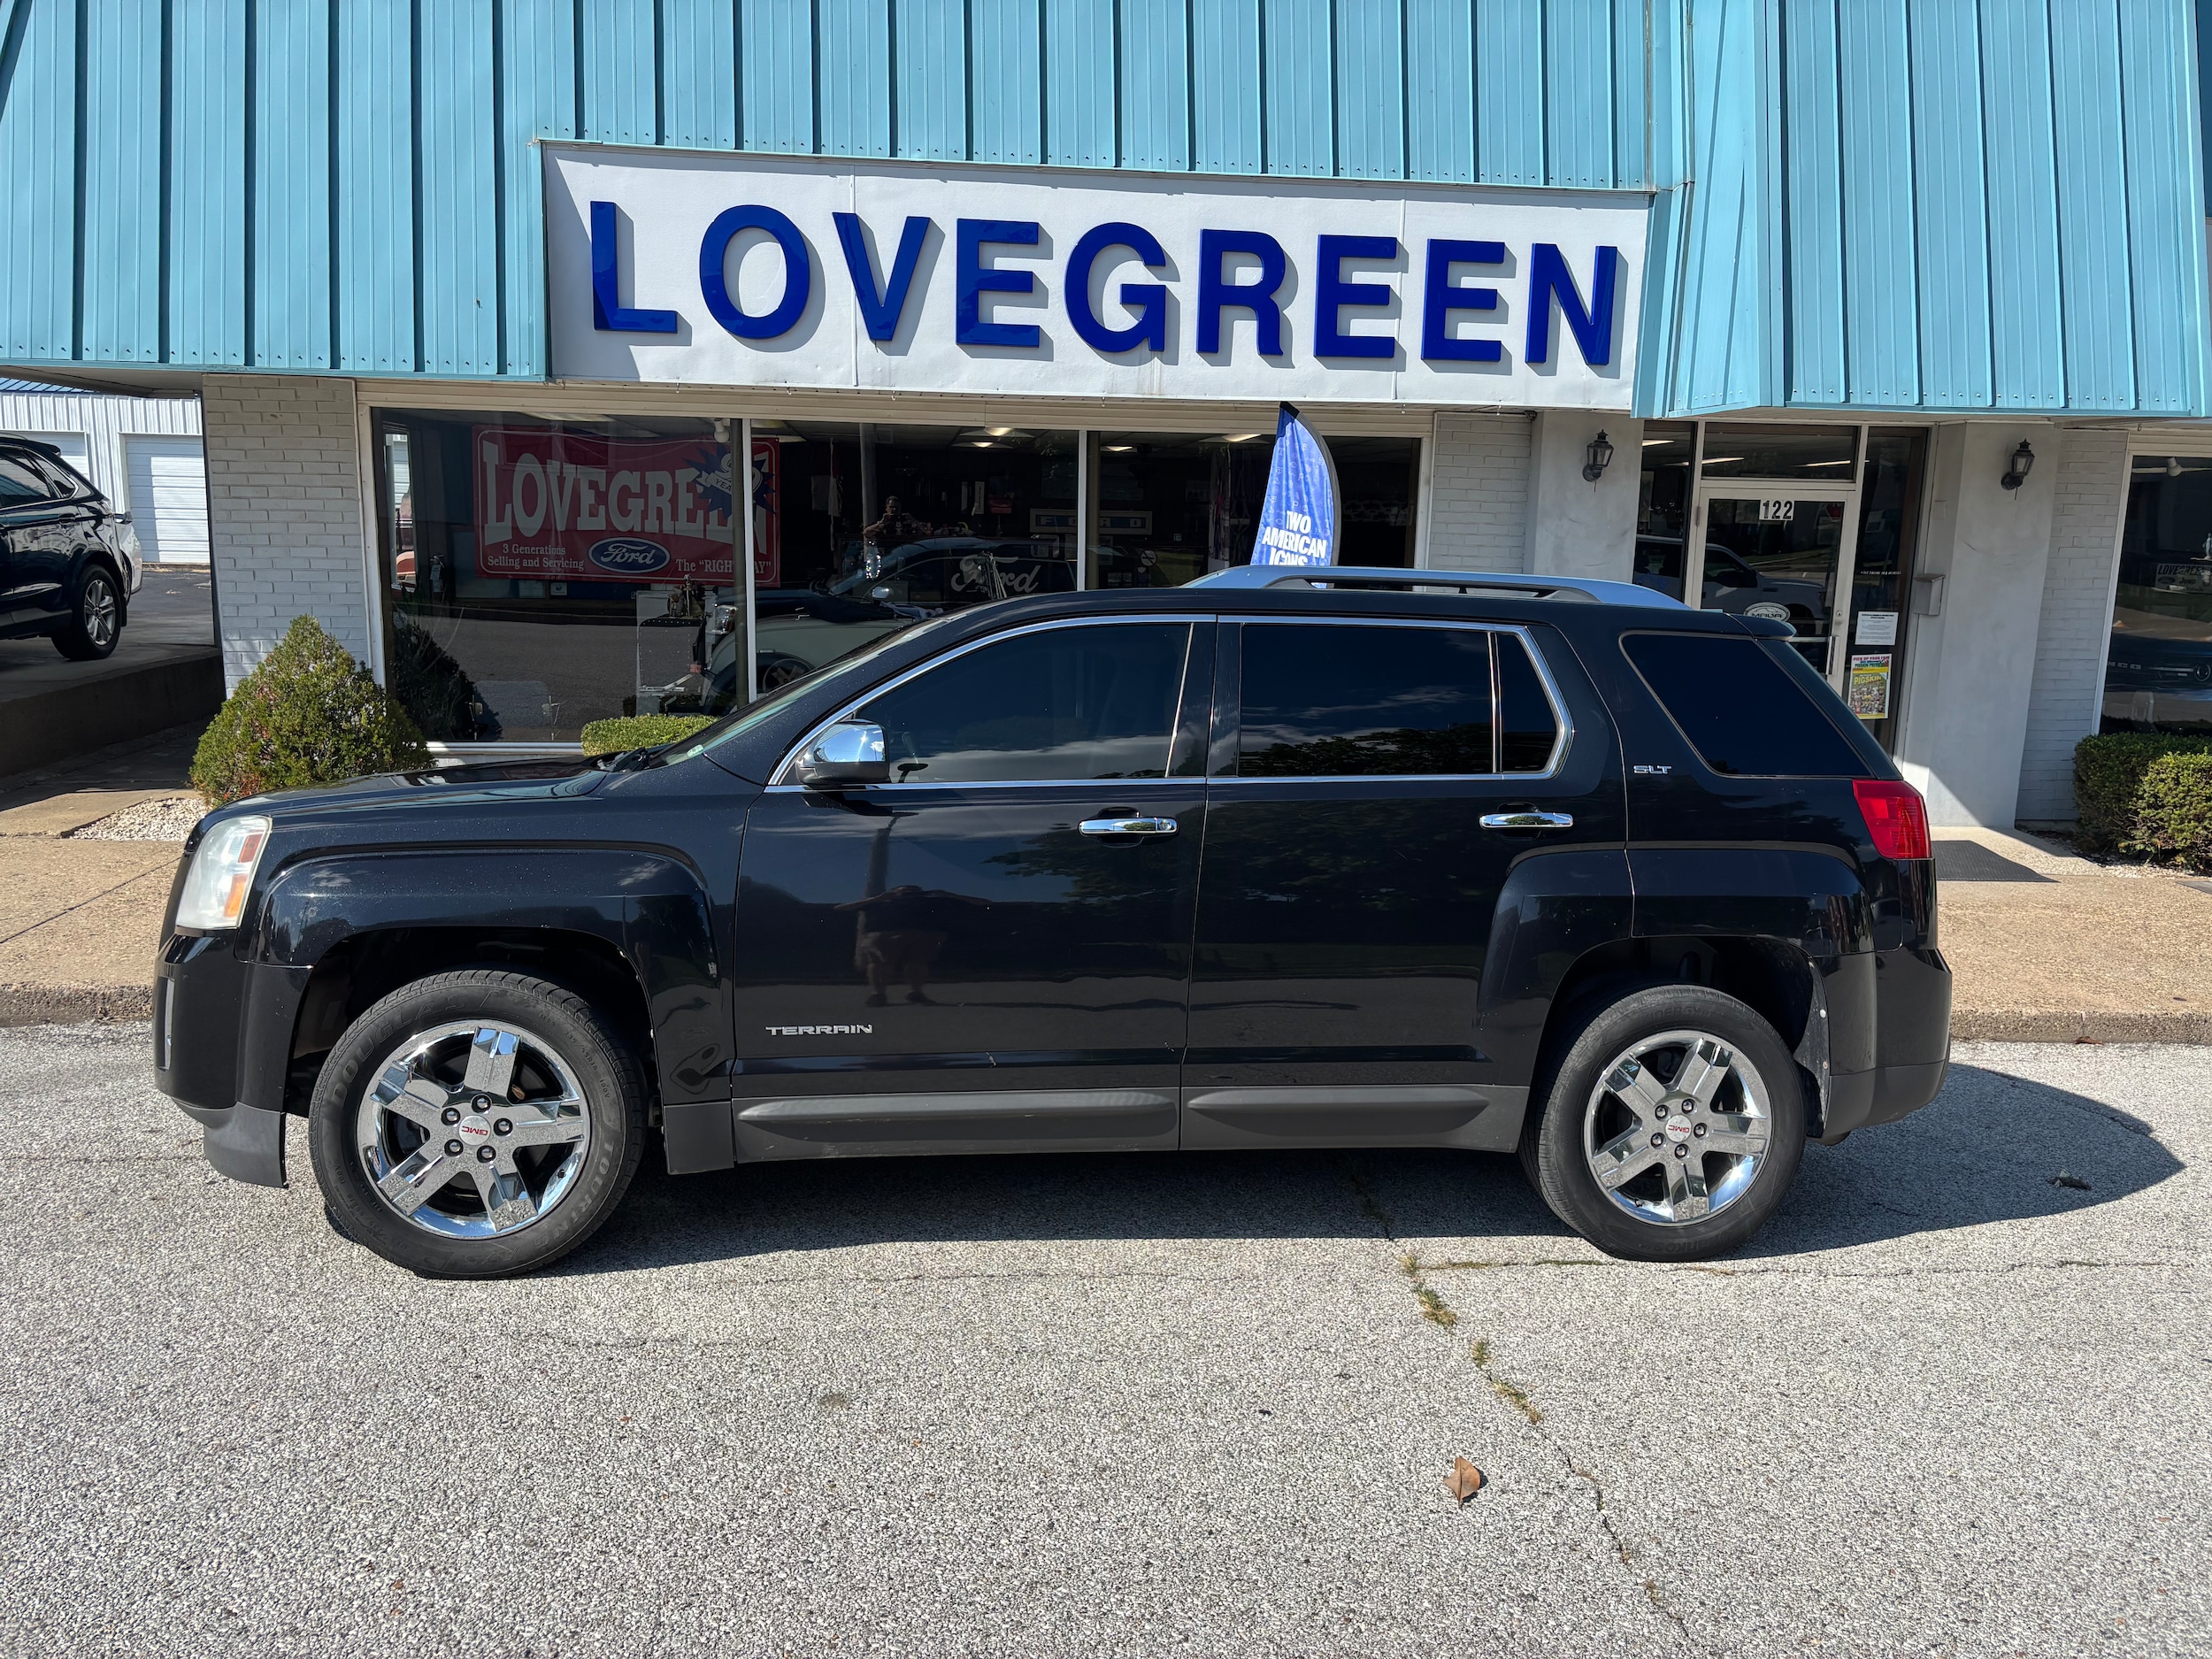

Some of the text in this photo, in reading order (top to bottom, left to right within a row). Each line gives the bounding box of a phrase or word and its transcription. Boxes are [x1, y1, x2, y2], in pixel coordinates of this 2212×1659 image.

[590, 200, 1618, 365] LOVEGREEN
[1763, 500, 1793, 520] 122
[1286, 511, 1312, 534] TWO
[503, 544, 566, 556] 3 Generations
[1262, 526, 1327, 559] AMERICAN
[600, 542, 656, 565] Ford
[488, 556, 584, 572] Selling and Servicing
[676, 558, 696, 572] The
[699, 559, 734, 573] “RIGH
[1854, 675, 1882, 685] PIGSKIN
[1633, 765, 1672, 774] SLT
[765, 1024, 873, 1036] TERRAIN
[331, 994, 469, 1105] DOUGLAS
[461, 1125, 489, 1137] GMC
[1667, 1124, 1691, 1134] GMC
[534, 1141, 616, 1248] TOURING
